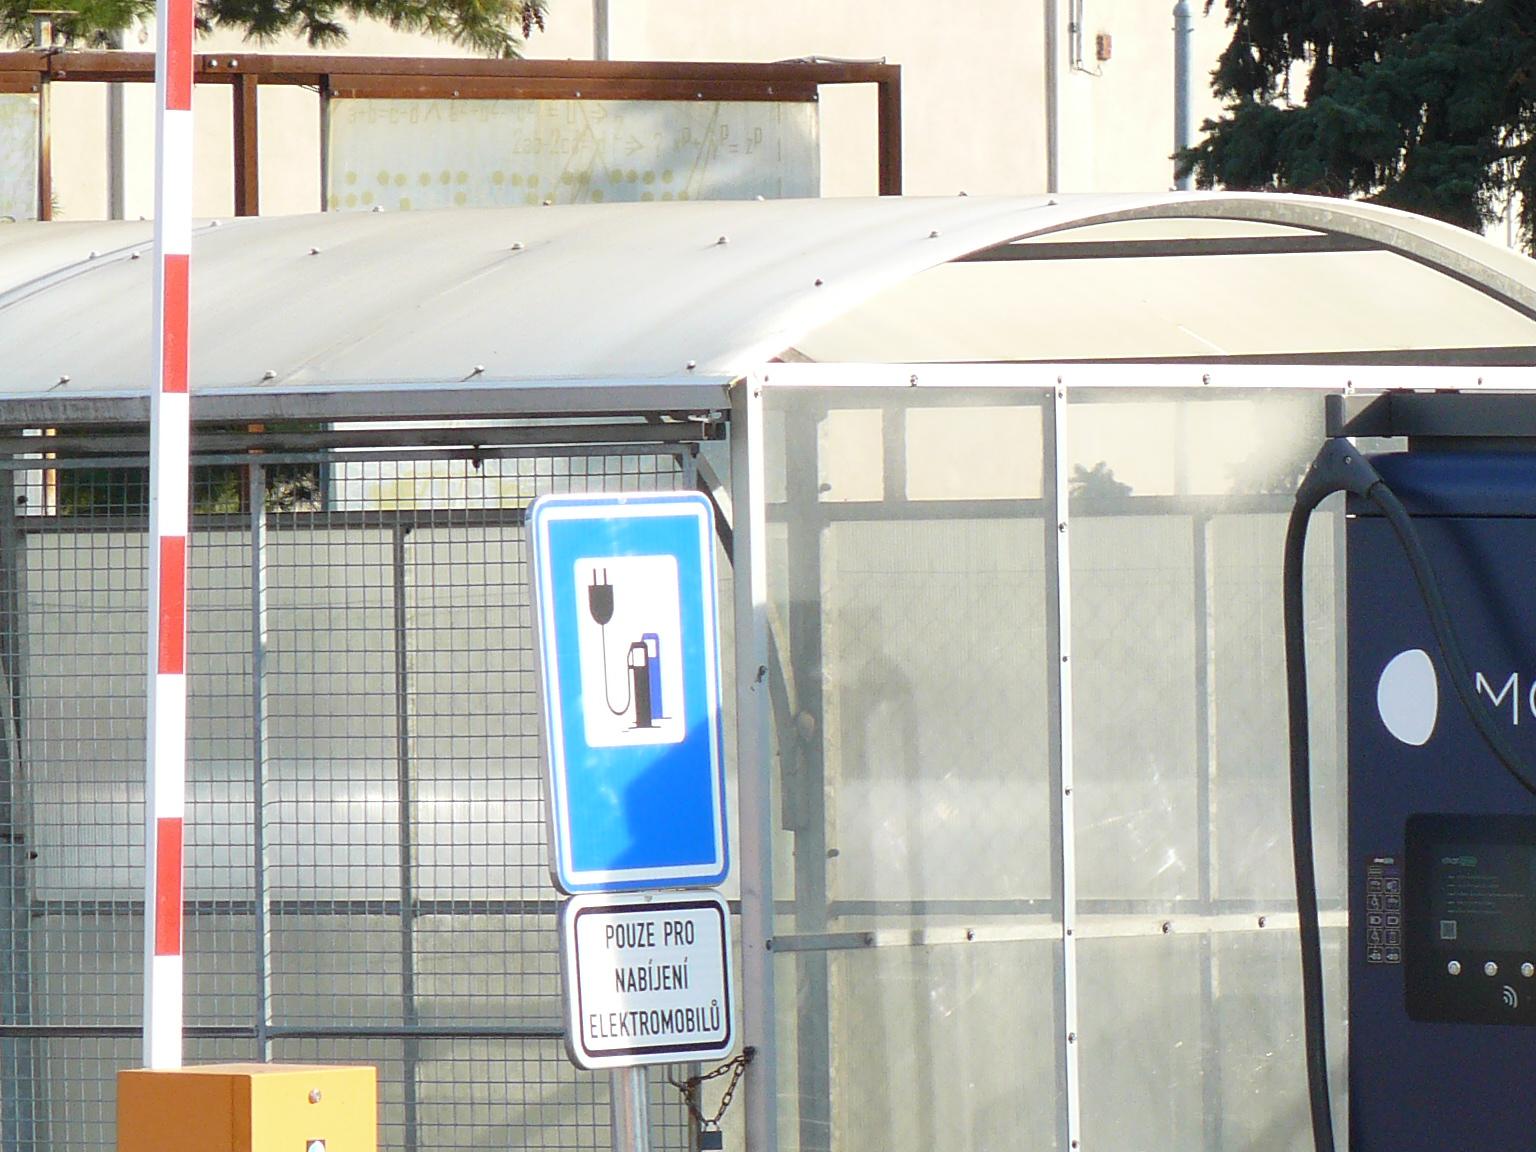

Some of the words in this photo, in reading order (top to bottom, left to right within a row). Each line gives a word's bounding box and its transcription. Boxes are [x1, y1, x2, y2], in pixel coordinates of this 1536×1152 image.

[606, 922, 655, 949] POUZE
[664, 920, 694, 947] PRO
[615, 957, 688, 993] NABÍJENÍ
[589, 999, 720, 1039] ELEKTROMOBILŮ
